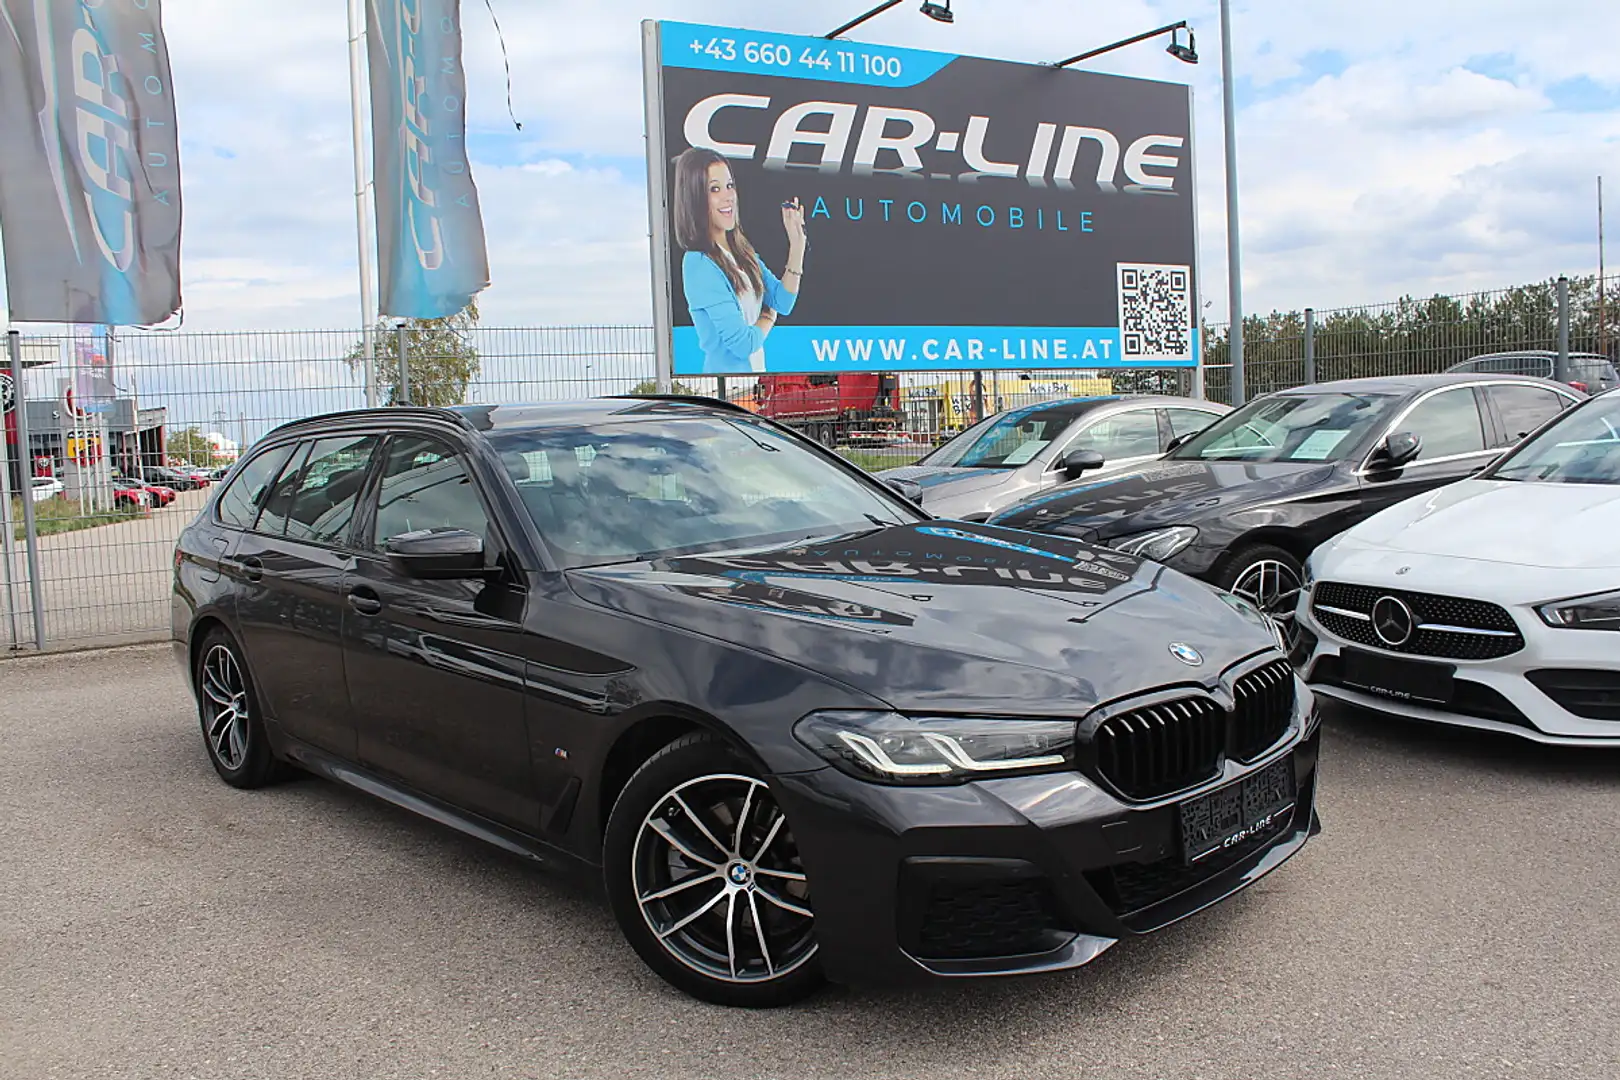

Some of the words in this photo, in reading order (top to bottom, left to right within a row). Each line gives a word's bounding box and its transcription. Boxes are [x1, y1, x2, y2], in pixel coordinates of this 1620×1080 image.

[689, 37, 737, 61] +43
[743, 41, 792, 66] 660
[798, 47, 832, 70] 44
[836, 51, 855, 73] 11
[861, 53, 902, 78] 100
[682, 92, 1185, 188] CAR-LINE
[811, 196, 1096, 233] AUTOMOBILE
[811, 338, 1113, 362] WWW.CAR-LINE.AT
[1223, 814, 1273, 848] CAR-LINE
